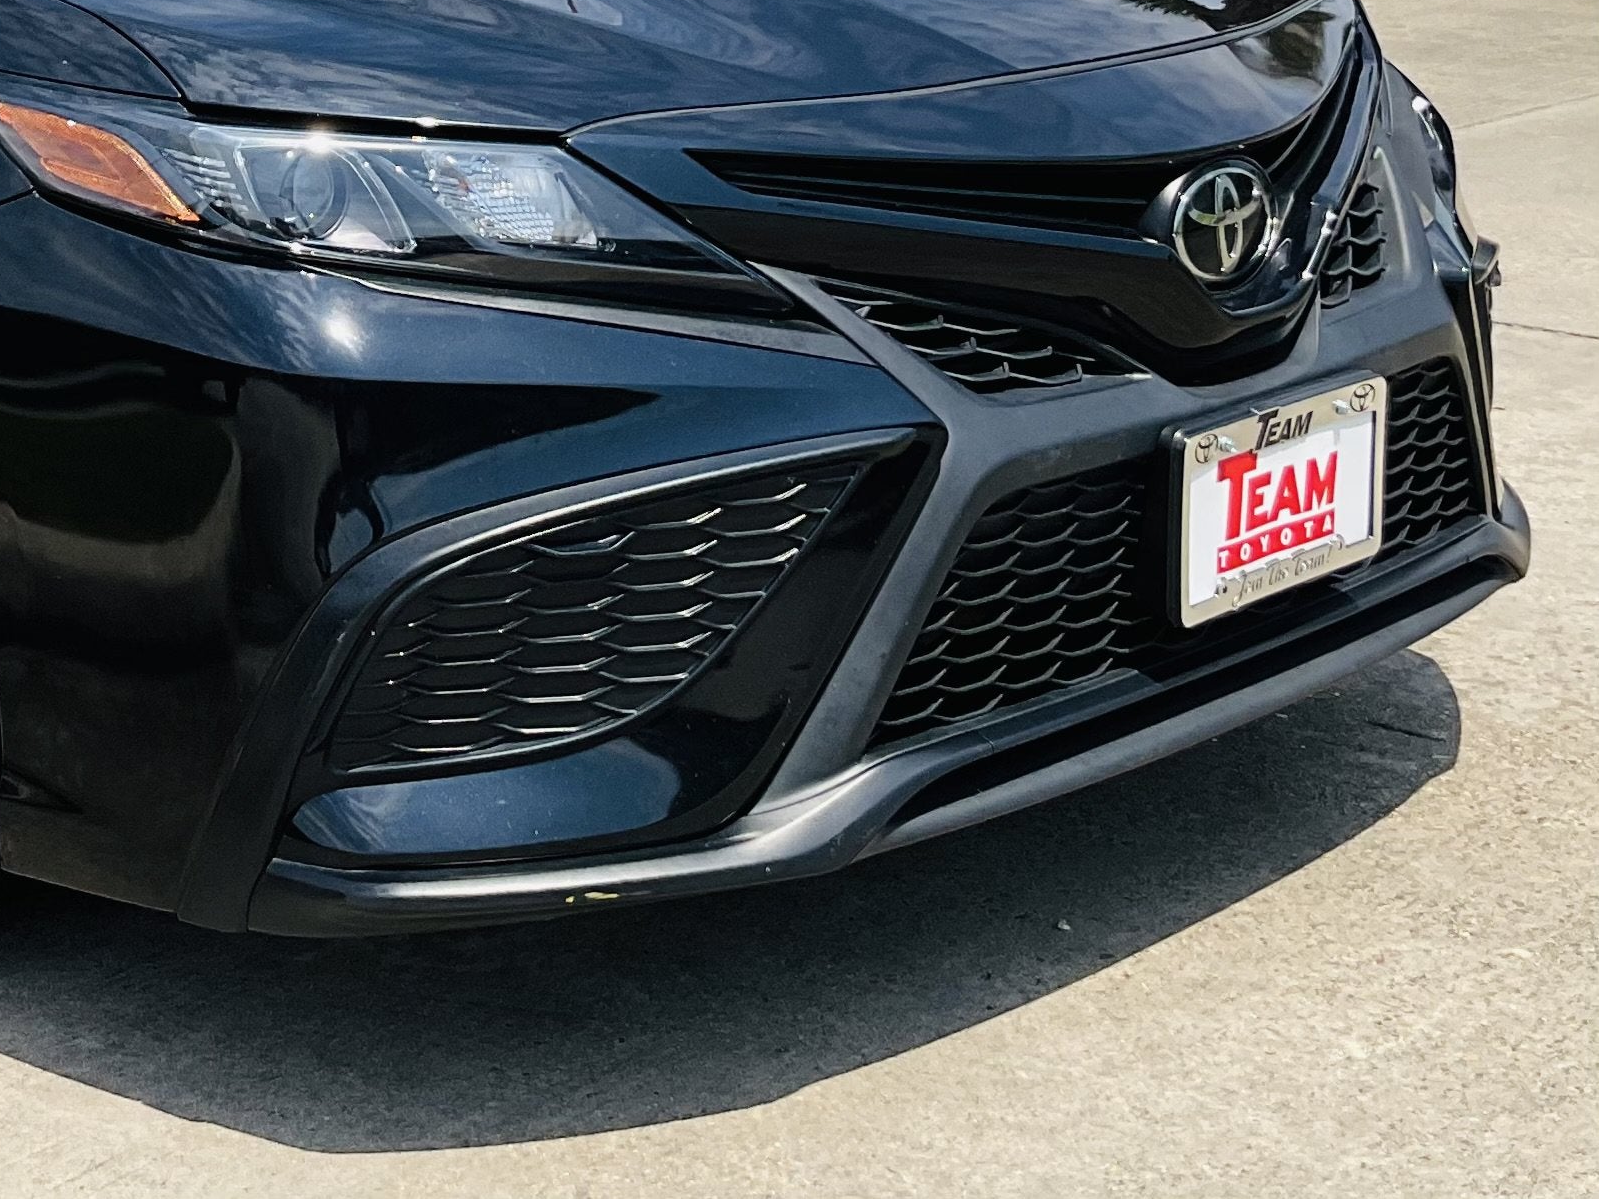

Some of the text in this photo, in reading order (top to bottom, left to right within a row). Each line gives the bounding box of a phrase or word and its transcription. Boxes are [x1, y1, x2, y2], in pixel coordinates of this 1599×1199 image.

[1256, 408, 1314, 450] TEAM
[1216, 449, 1338, 541] TEAM
[1218, 513, 1334, 569] TOYOTA
